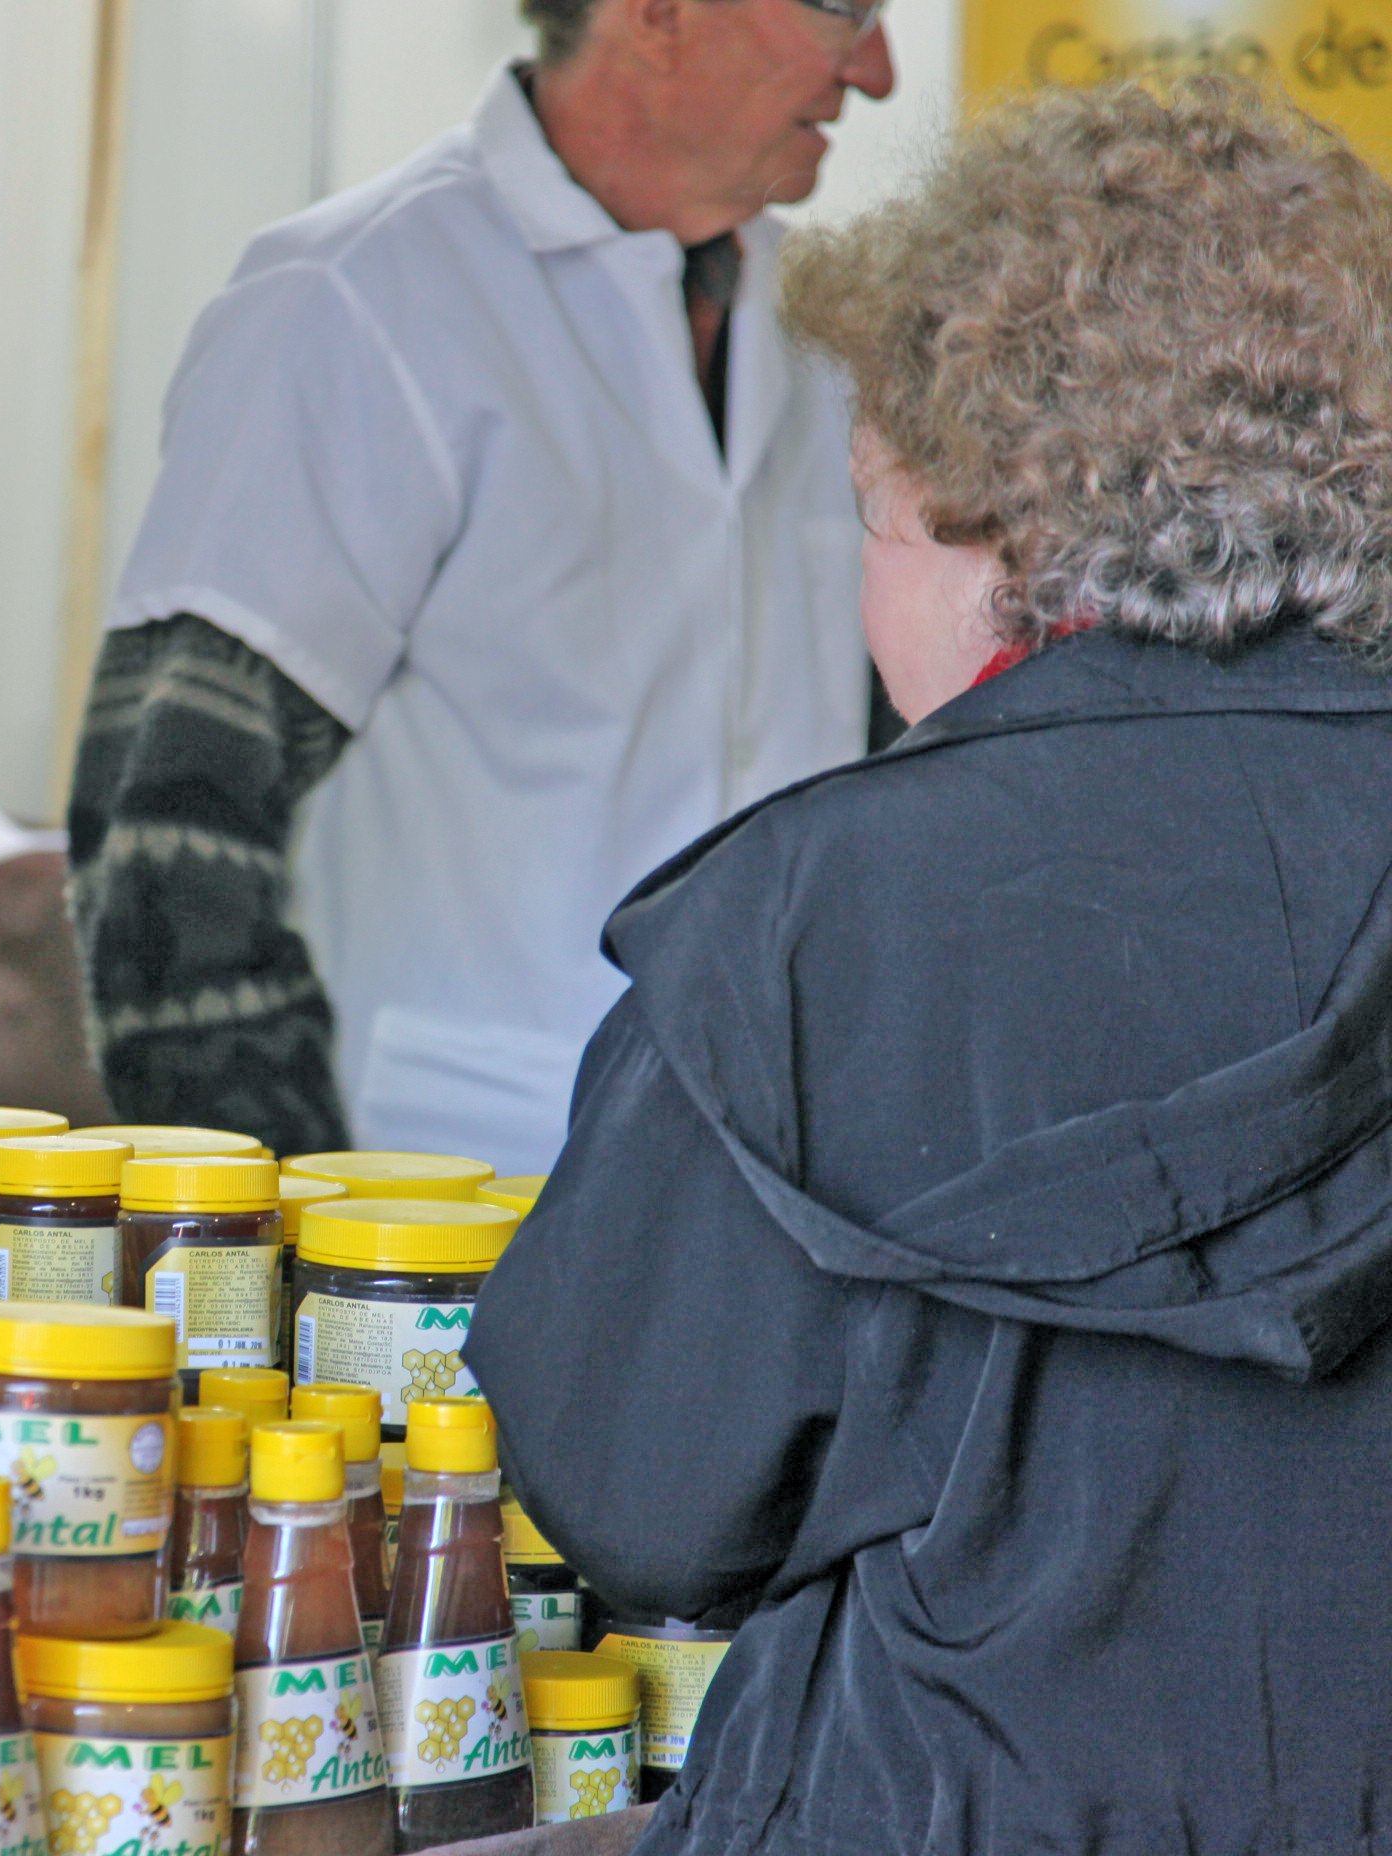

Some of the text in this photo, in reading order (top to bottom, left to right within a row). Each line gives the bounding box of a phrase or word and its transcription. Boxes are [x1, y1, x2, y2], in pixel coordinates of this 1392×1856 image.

[13, 1229, 44, 1237] CARLOS
[319, 1298, 371, 1311] CARLOS ANTAL
[12, 1510, 118, 1547] ntal
[511, 1596, 575, 1620] EL
[621, 1640, 680, 1652] CARLOS ANTAL
[64, 1742, 214, 1771] MEL
[463, 1730, 531, 1773] Anta
[569, 1731, 636, 1762] ME
[311, 1752, 385, 1793] Anta
